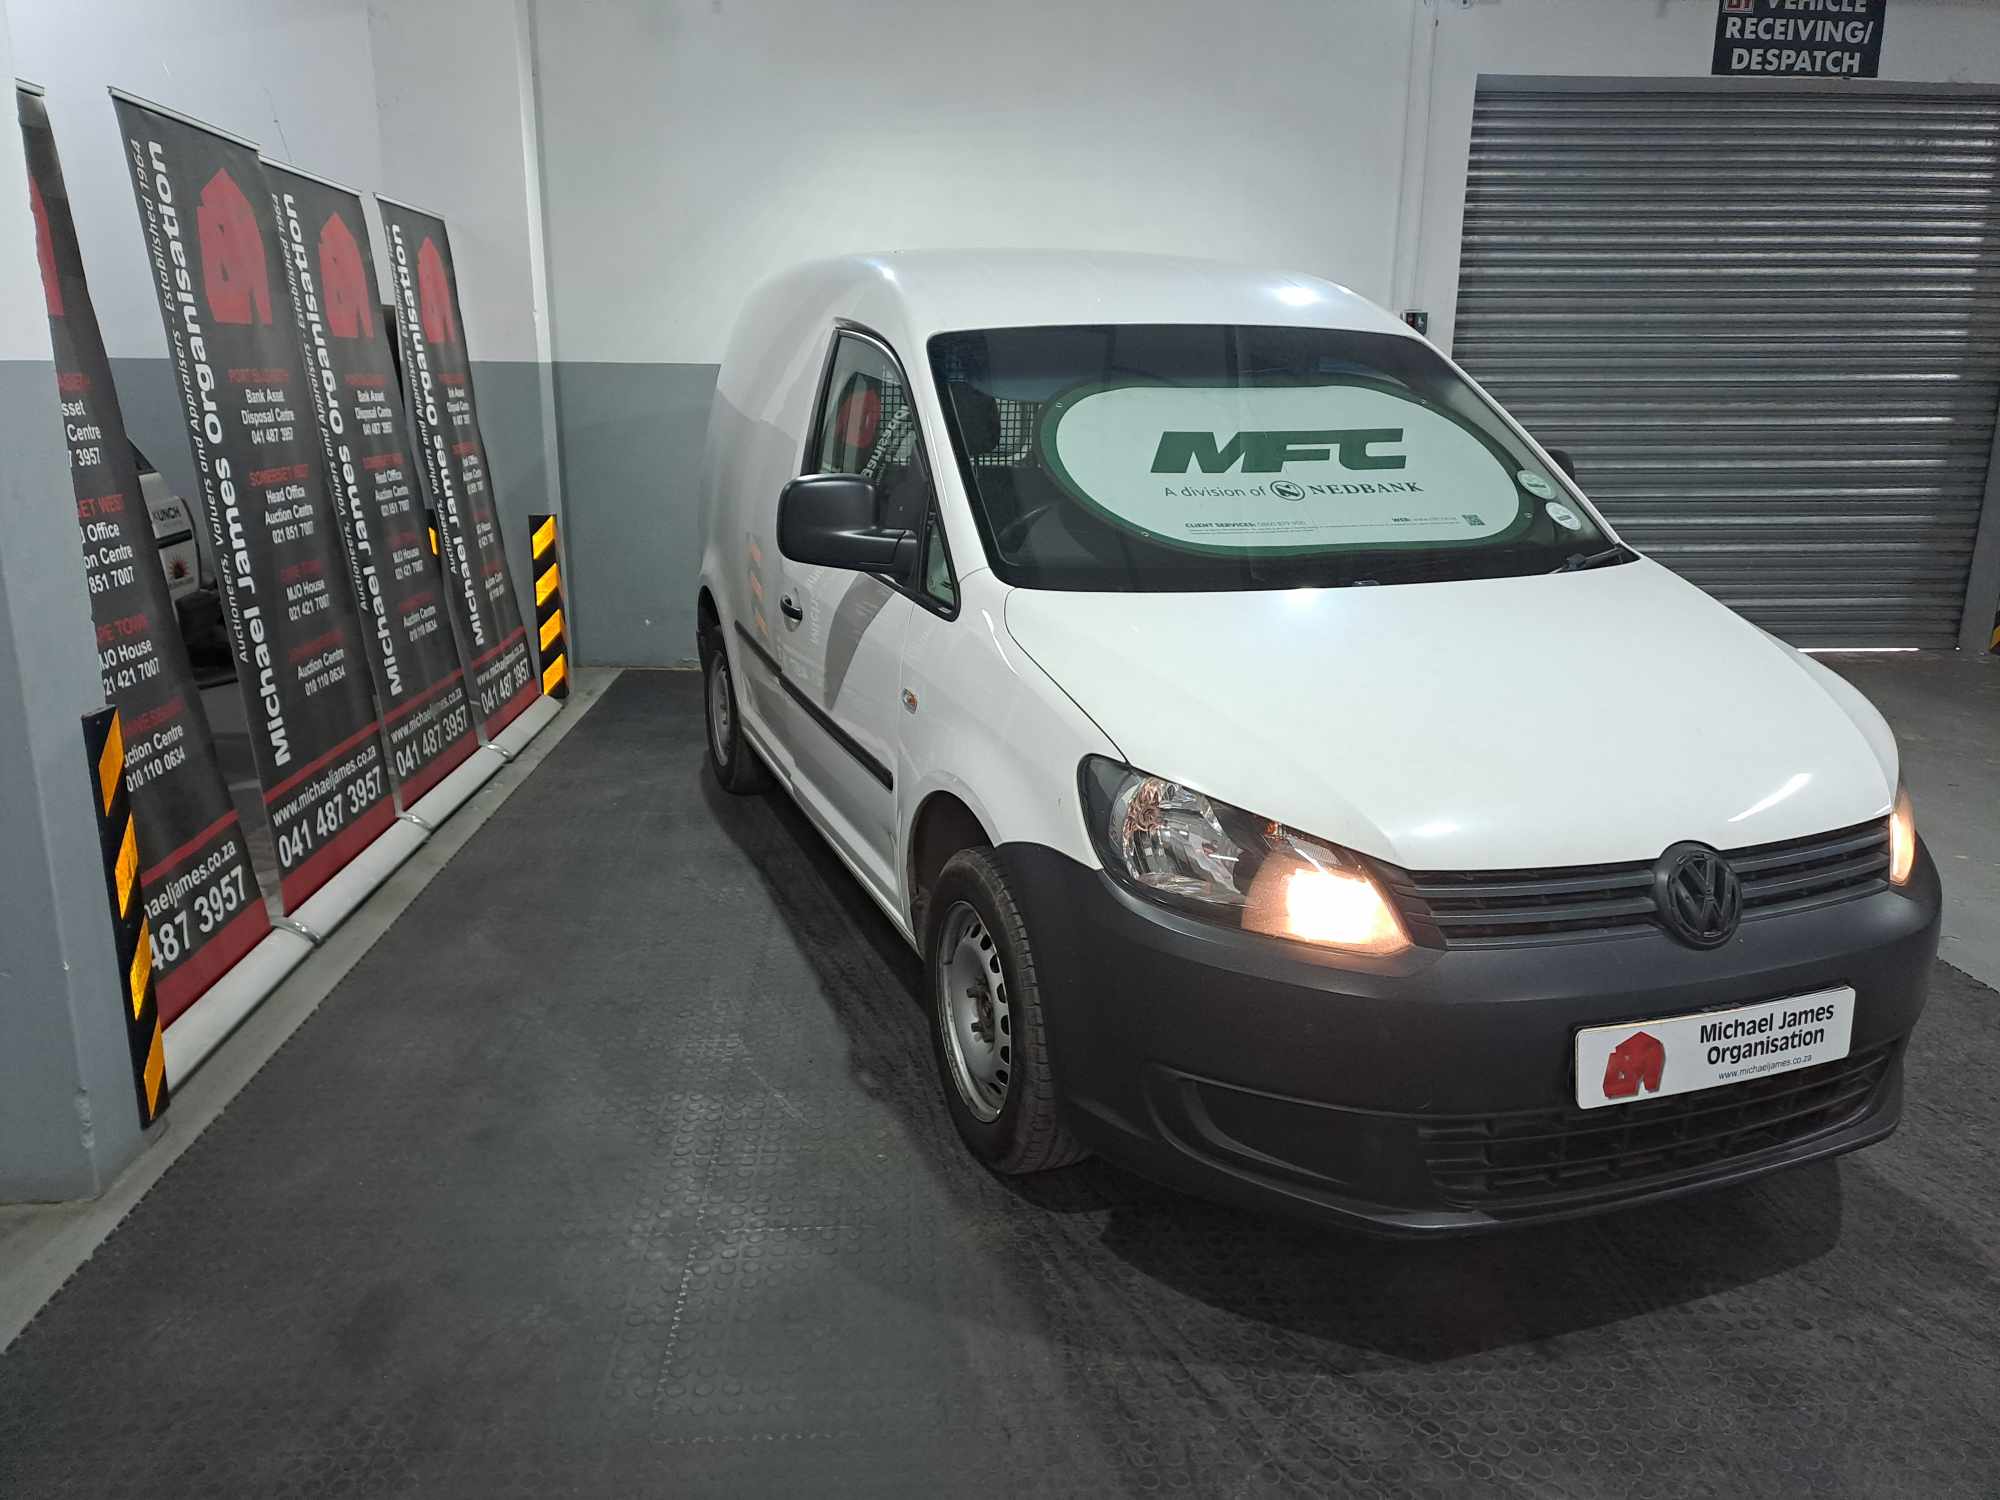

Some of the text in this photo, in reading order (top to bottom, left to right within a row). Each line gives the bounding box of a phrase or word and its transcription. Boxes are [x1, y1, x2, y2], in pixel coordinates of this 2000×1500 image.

[1725, 17, 1874, 45] RECEIVING/
[1731, 48, 1861, 74] DESPATCH
[130, 137, 151, 192] 1964
[142, 194, 175, 312] Established
[283, 193, 344, 435] Organisation
[391, 223, 438, 427] Organisation
[172, 330, 201, 430] Appraisers
[62, 400, 86, 417] sset
[67, 423, 102, 442] Centre
[148, 140, 292, 768] Michael James Organisation
[192, 436, 208, 472] and
[320, 428, 334, 458] and
[1150, 427, 1407, 474] MFC
[76, 447, 101, 466] 3957
[339, 444, 372, 556] James
[434, 434, 460, 529] James
[1164, 487, 1178, 498] A
[1181, 485, 1250, 499] division
[1250, 485, 1267, 498] of
[1309, 481, 1424, 496] NEDBANK
[88, 521, 120, 542] Office
[203, 479, 225, 546] Valuers
[99, 543, 133, 565] Centre
[88, 565, 135, 594] 851 7007
[453, 535, 485, 647] Michael
[221, 553, 249, 664] Auctioneers,
[363, 565, 403, 697] Michael
[119, 639, 152, 663] House
[103, 657, 160, 697] 21 421 7007
[480, 686, 500, 715] 041
[499, 672, 512, 699] 487
[153, 723, 184, 751] Centre
[396, 704, 468, 777] 041 487 3957
[126, 746, 187, 793] 010 110 0634
[272, 745, 377, 827] www.michaeljames.co.za
[278, 765, 382, 868] 041 487 3957
[148, 863, 246, 972] 487 3957
[1700, 1003, 1834, 1044] Michael James
[1707, 1027, 1825, 1065] Organisation
[1718, 1054, 1812, 1080] www.michaeljames.co.za
